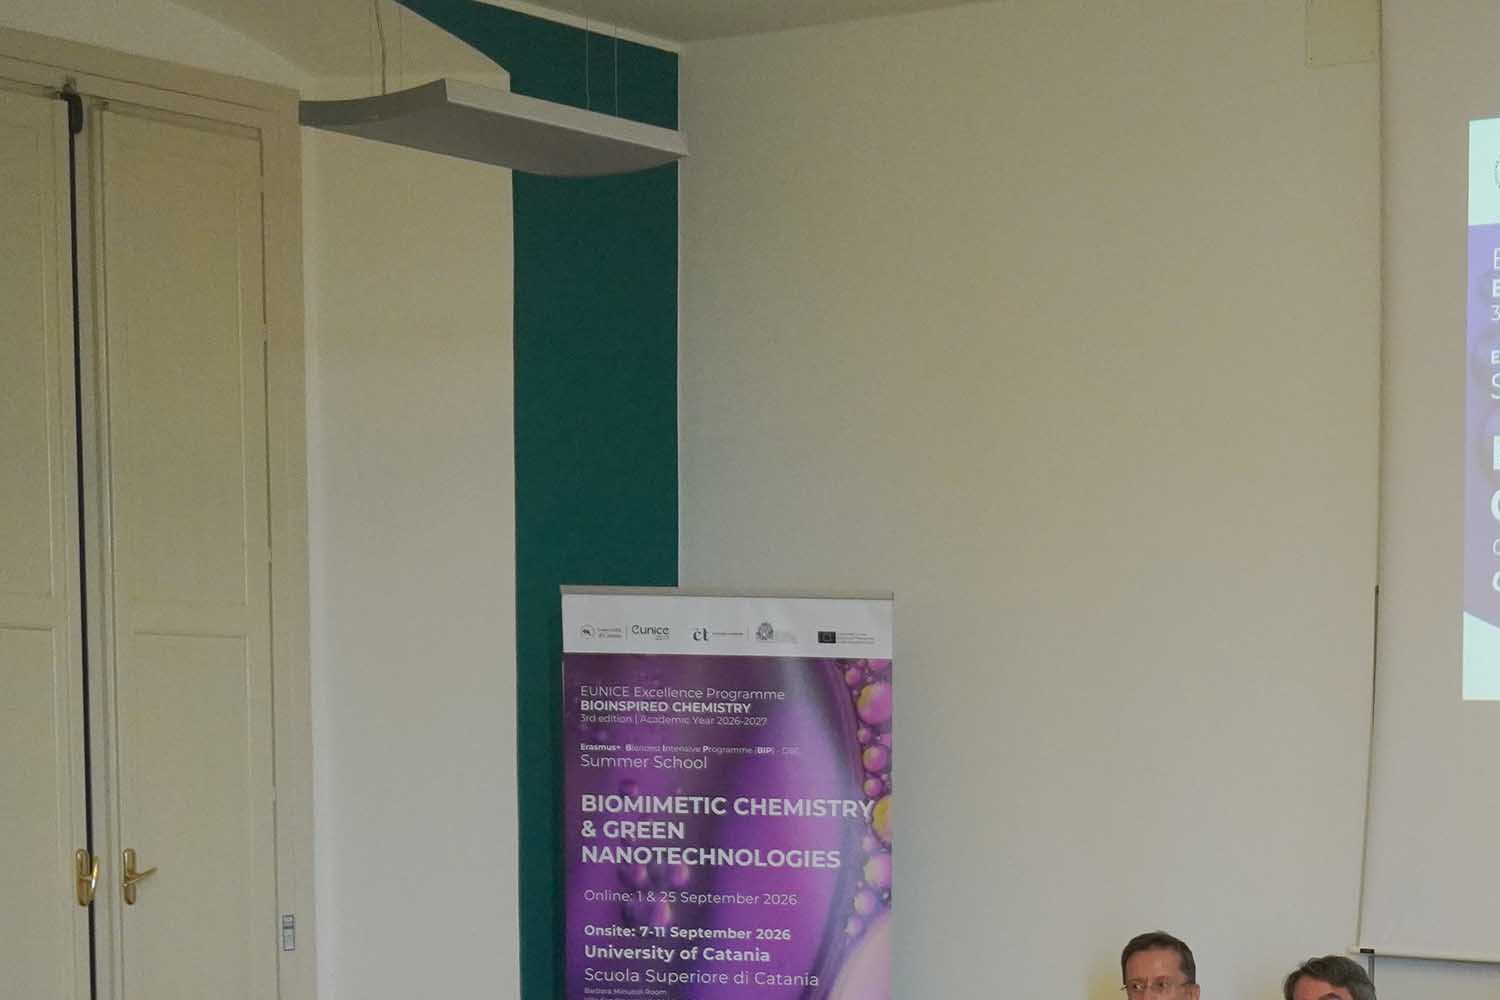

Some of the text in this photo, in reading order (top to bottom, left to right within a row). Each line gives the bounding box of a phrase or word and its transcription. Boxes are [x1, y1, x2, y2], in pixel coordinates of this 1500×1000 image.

[580, 685, 785, 703] EUNICE Excellence Programme
[580, 700, 751, 714] BIOINSPIRED CHEMISTRY
[580, 713, 768, 726] 3rd edition Academic Year 2026-2027
[580, 754, 707, 769] Summer School
[581, 794, 875, 818] BIOMIMETIC CHEMISTRY
[581, 820, 685, 840] & GREEN
[581, 845, 841, 869] NANOTECHNOLOGIES
[584, 889, 633, 902] Online:
[645, 890, 657, 903] &
[660, 891, 677, 903] 25
[680, 890, 759, 906] September
[763, 893, 797, 906] 2026
[584, 924, 791, 941] Onsite: 7-11 September 2026
[584, 944, 771, 963] University of Catania
[584, 967, 819, 988] Scuola Superiore di Catania
